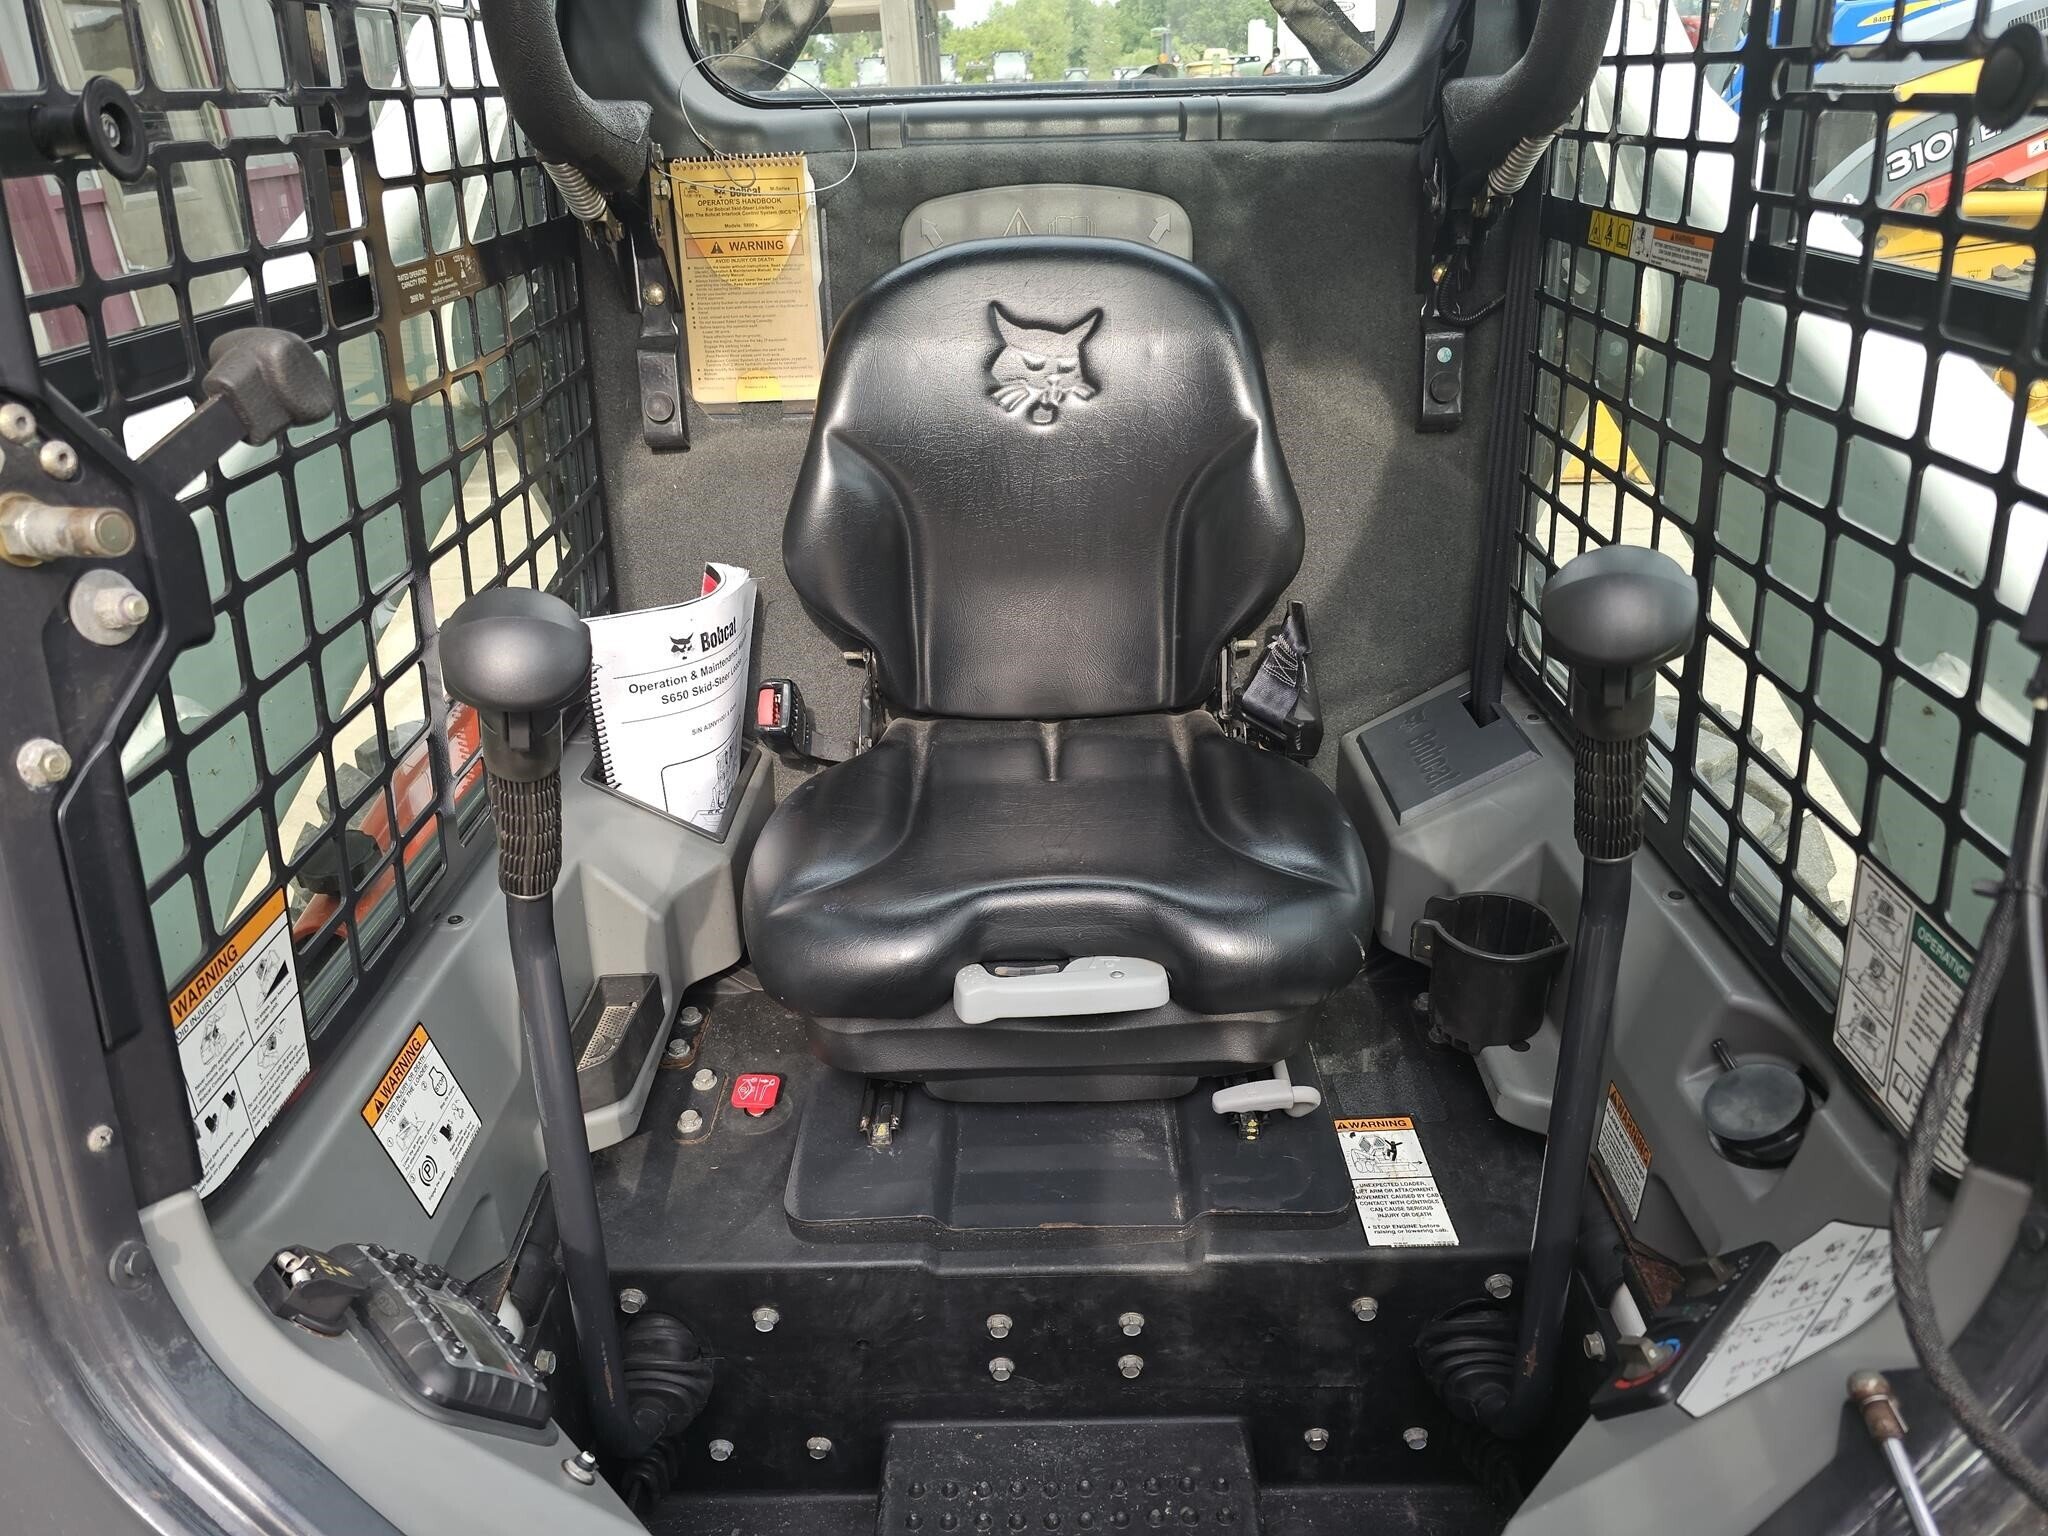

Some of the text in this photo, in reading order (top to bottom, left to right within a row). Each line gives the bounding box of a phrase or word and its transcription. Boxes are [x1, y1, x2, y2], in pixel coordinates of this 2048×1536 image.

[697, 199, 740, 207] OPERATOR'S
[730, 186, 761, 197] Bobcat
[729, 240, 784, 252] WARNING
[700, 617, 737, 652] Bobcat
[628, 674, 688, 695] Operation
[690, 670, 698, 681] &
[660, 688, 690, 706] S650
[692, 672, 730, 697] Skid-Steer
[173, 941, 238, 1017] WARNING
[190, 996, 213, 1026] INJURY
[213, 984, 223, 1000] OR
[224, 961, 244, 988] DEATH
[379, 1036, 421, 1100] WARNING
[434, 1074, 445, 1092] STOP
[384, 1053, 425, 1120] AVOID INJURY OR DEATH
[389, 1114, 396, 1125] TO
[395, 1096, 407, 1116] LEAVE
[406, 1085, 414, 1098] THE
[1348, 1119, 1407, 1129] WARNING
